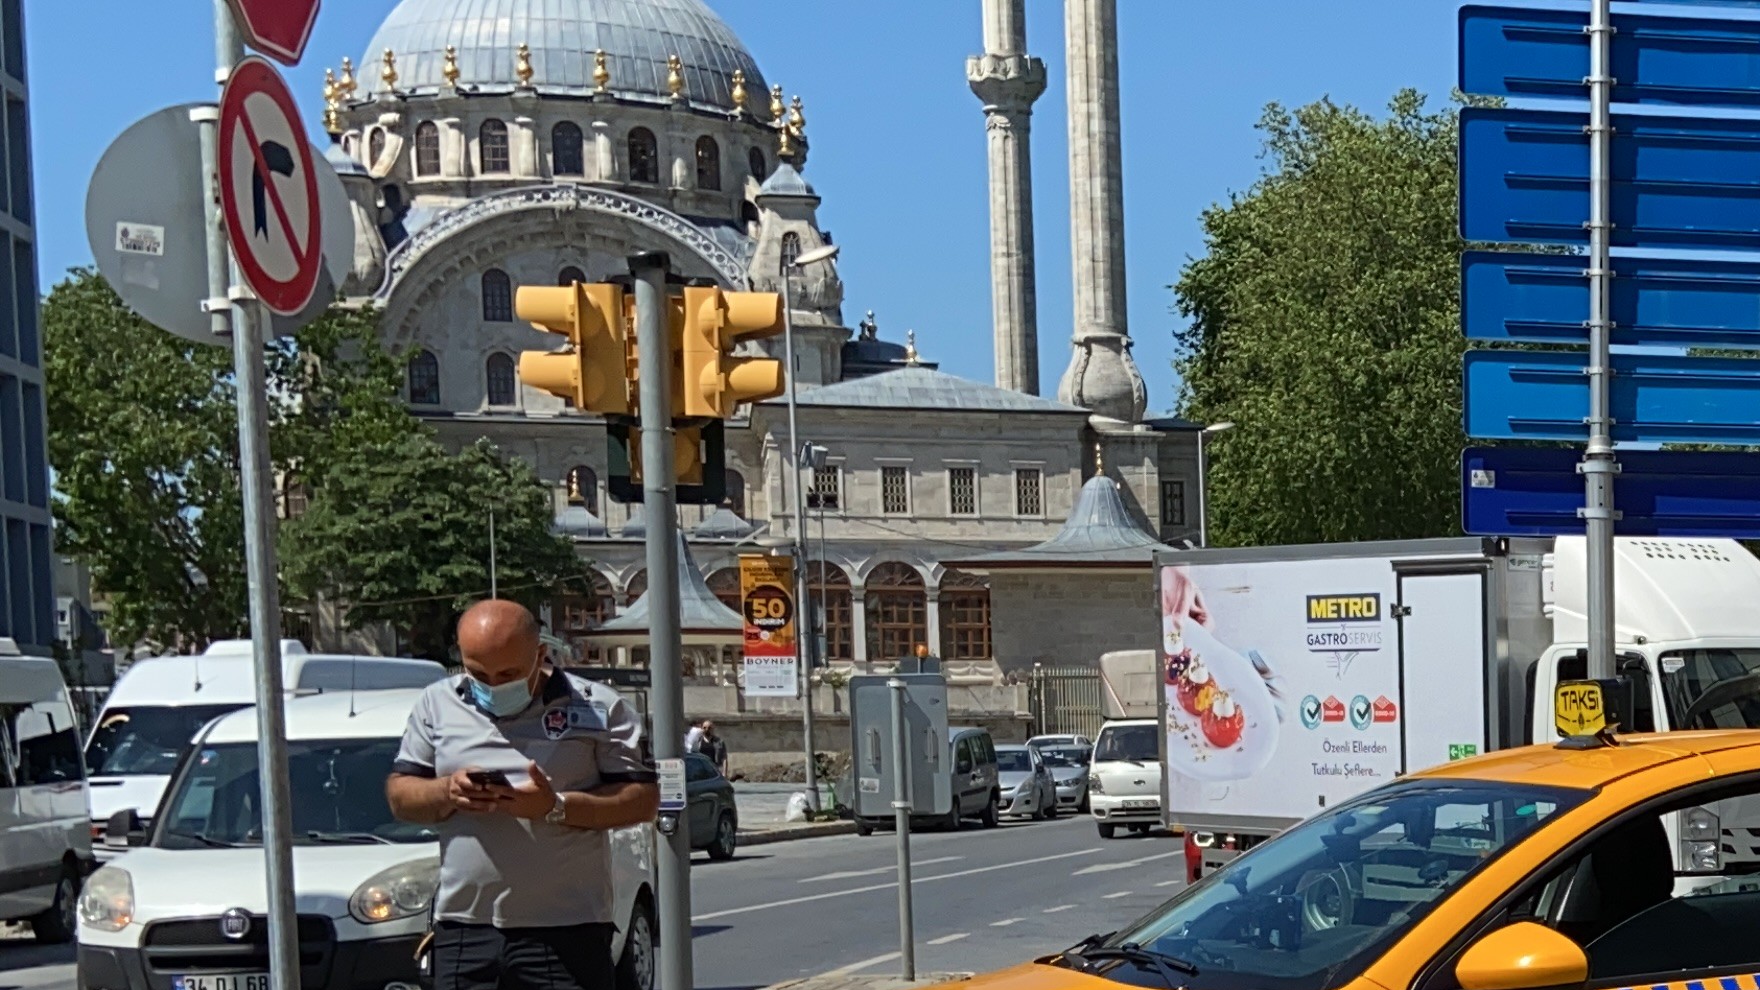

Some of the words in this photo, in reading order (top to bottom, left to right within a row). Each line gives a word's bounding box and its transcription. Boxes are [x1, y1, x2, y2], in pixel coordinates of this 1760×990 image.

[752, 598, 786, 619] 50
[1310, 597, 1377, 619] METRO
[1322, 738, 1350, 754] Özenli
[1352, 740, 1387, 754] Ellerden
[1312, 763, 1342, 776] Tutkulu
